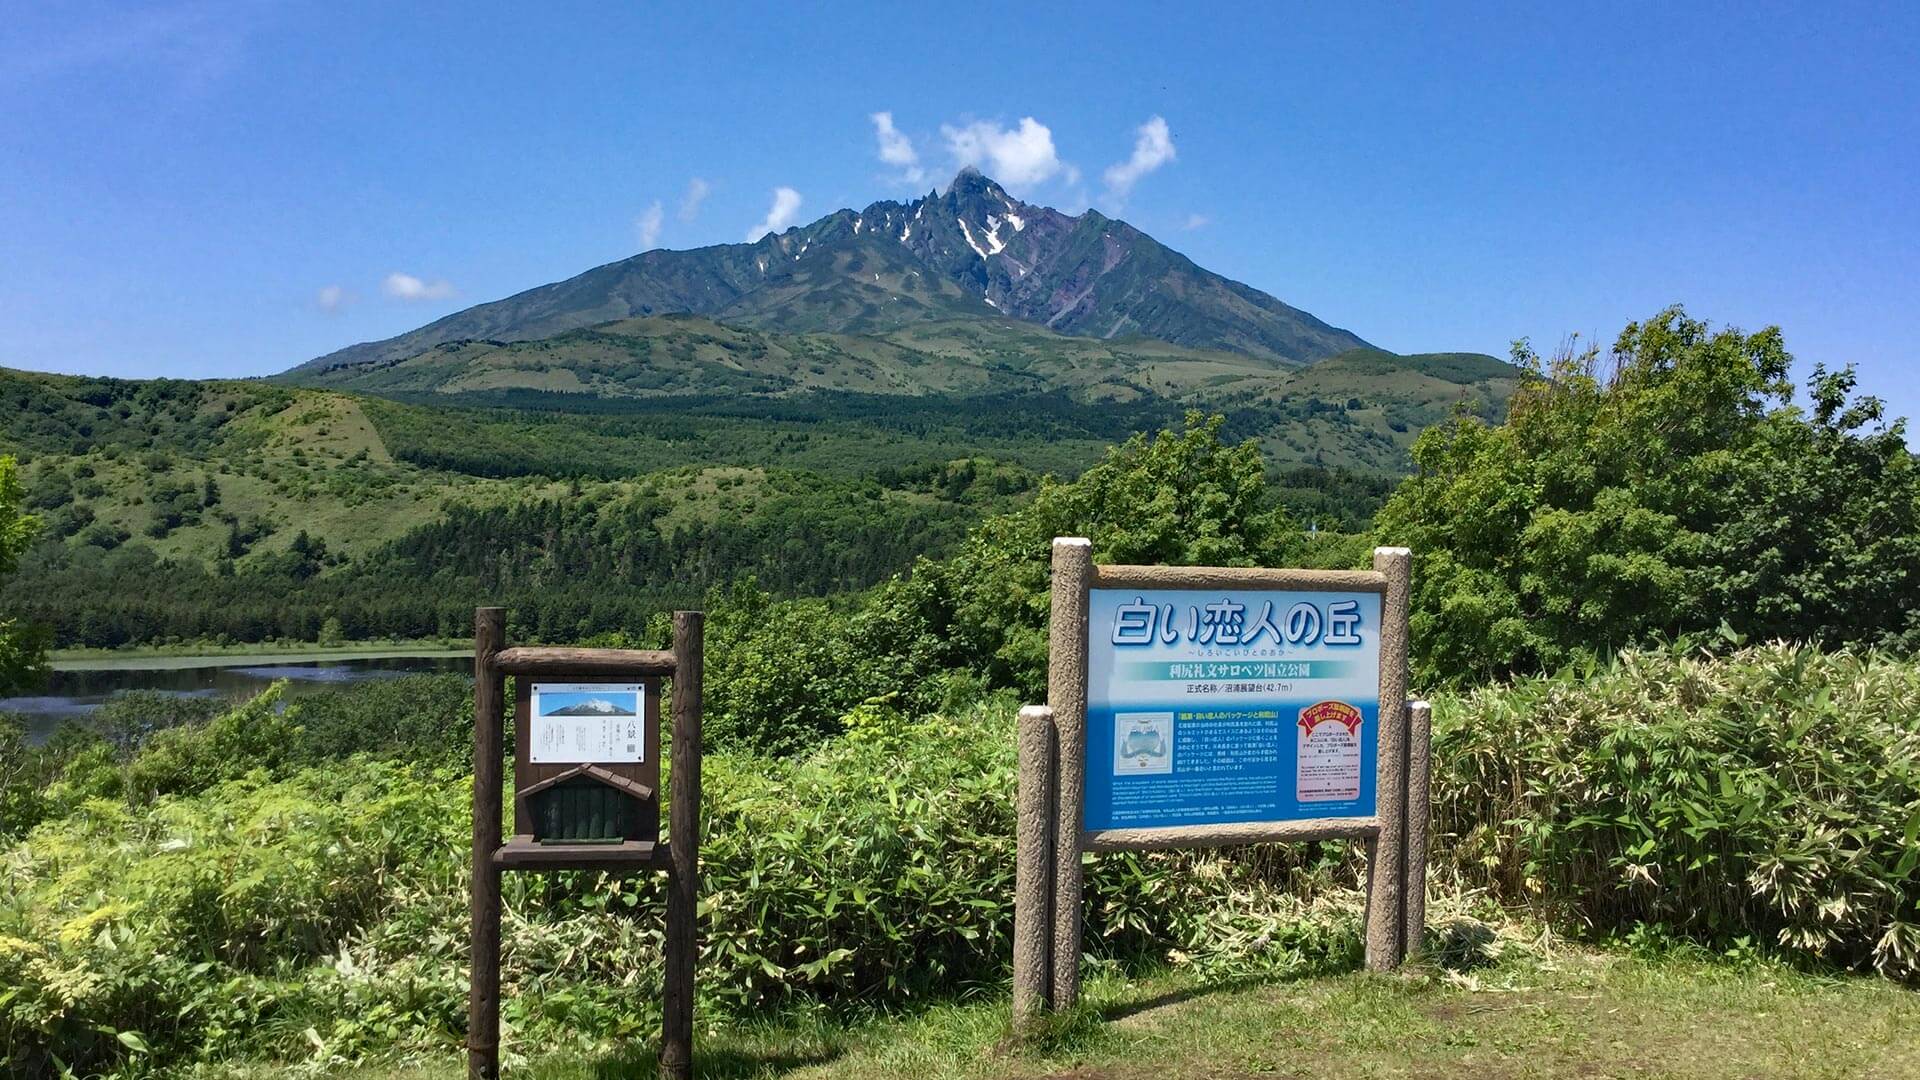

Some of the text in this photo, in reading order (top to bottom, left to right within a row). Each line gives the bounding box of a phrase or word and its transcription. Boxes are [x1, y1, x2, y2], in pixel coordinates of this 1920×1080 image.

[1111, 596, 1362, 645] 白い恋人の丘
[1169, 663, 1310, 678] 利尻礼文サロベツ国立公園
